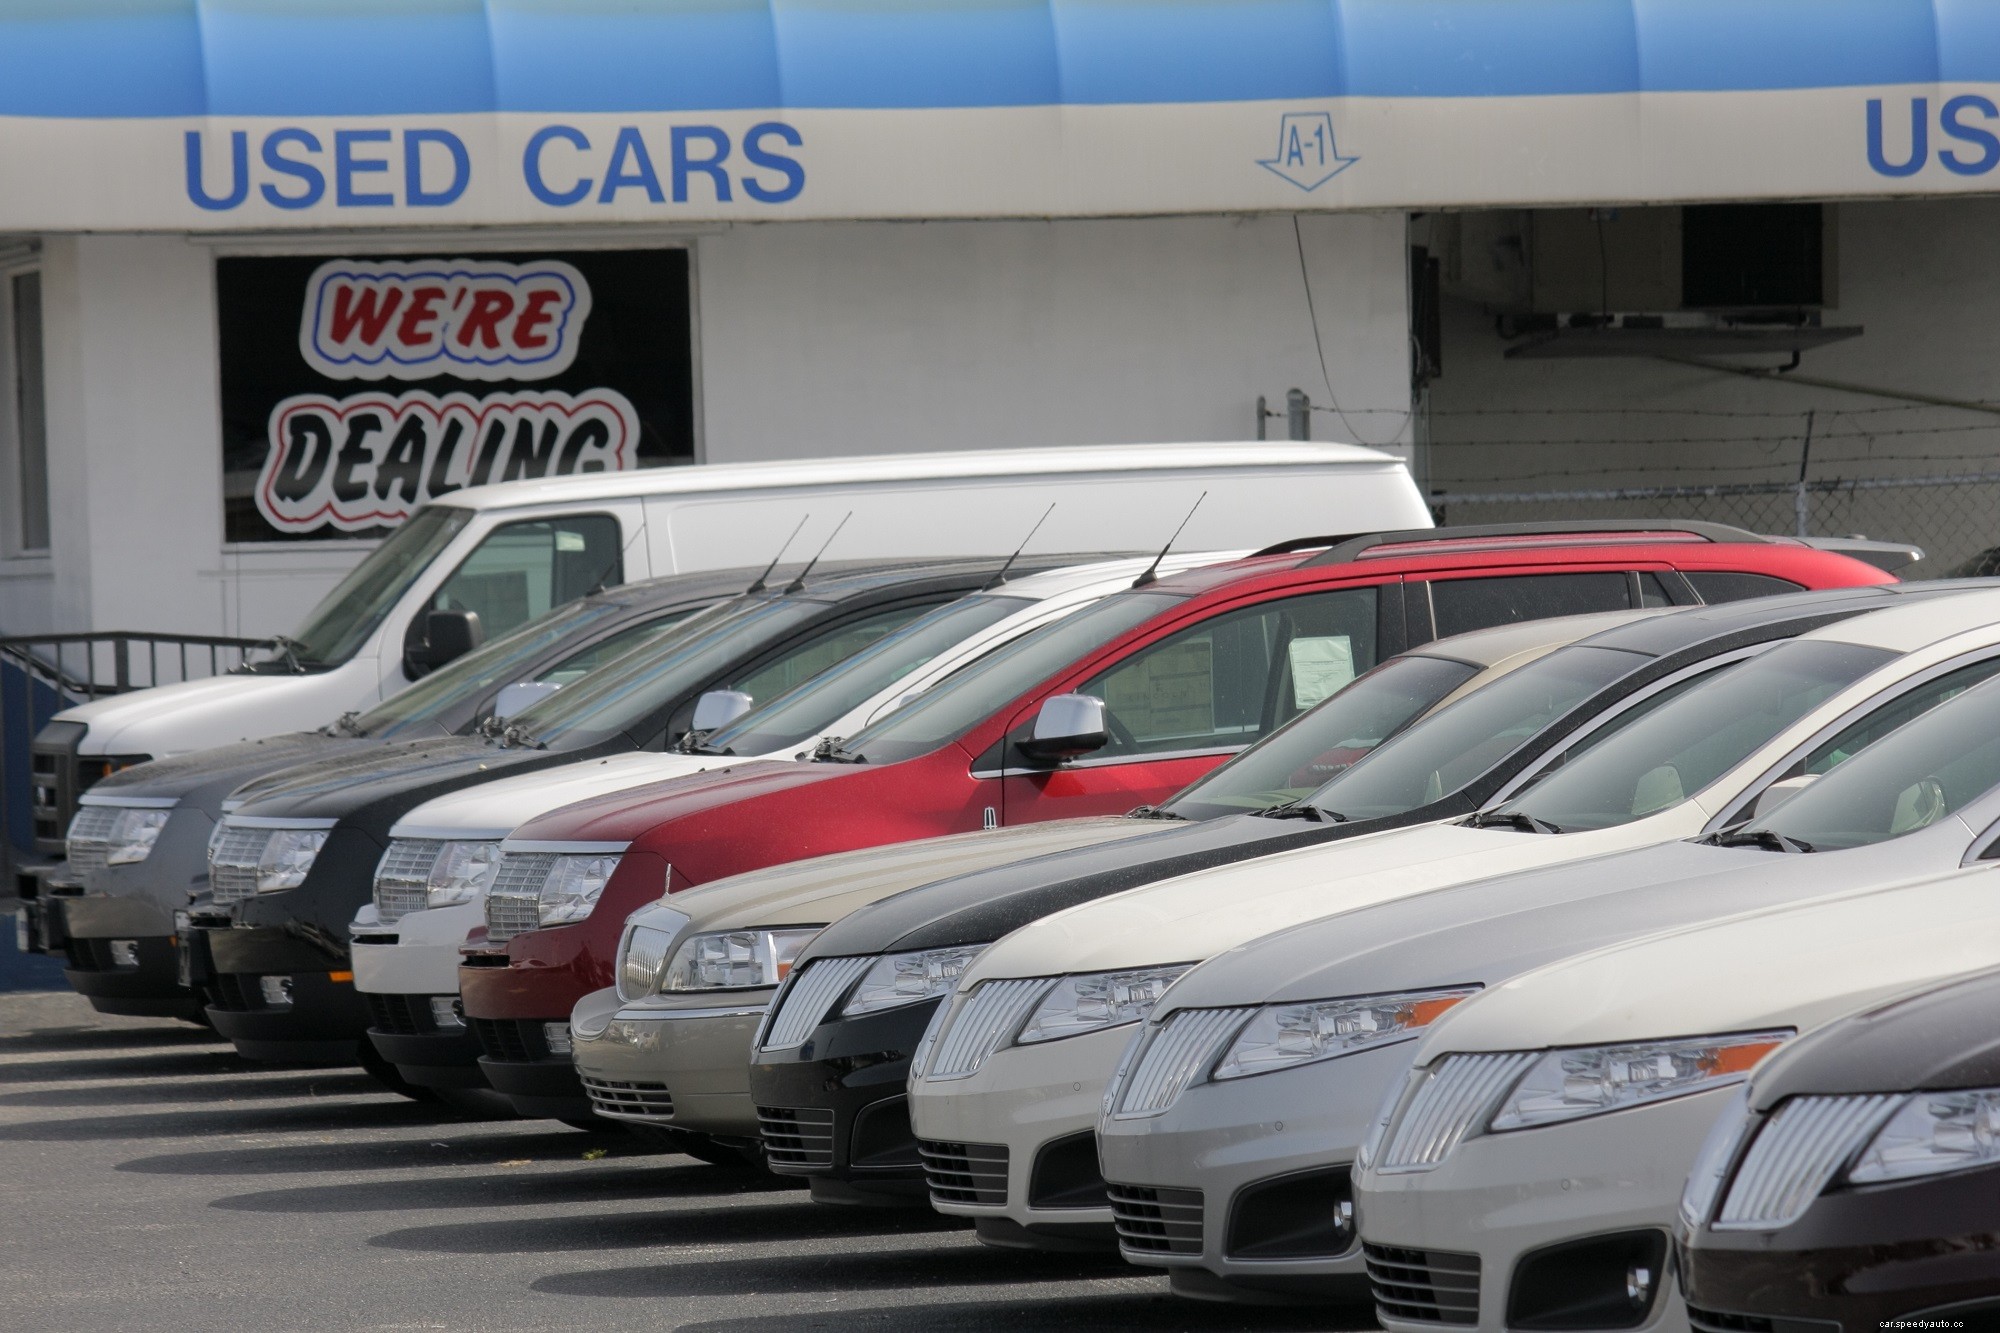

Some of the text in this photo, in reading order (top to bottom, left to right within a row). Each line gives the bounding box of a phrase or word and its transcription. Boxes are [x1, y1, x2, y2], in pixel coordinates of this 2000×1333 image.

[184, 121, 806, 211] USED CARS
[1286, 124, 1326, 167] A-1
[1865, 94, 2000, 177] US
[330, 285, 562, 349] WE'RE
[273, 411, 610, 505] DEALING
